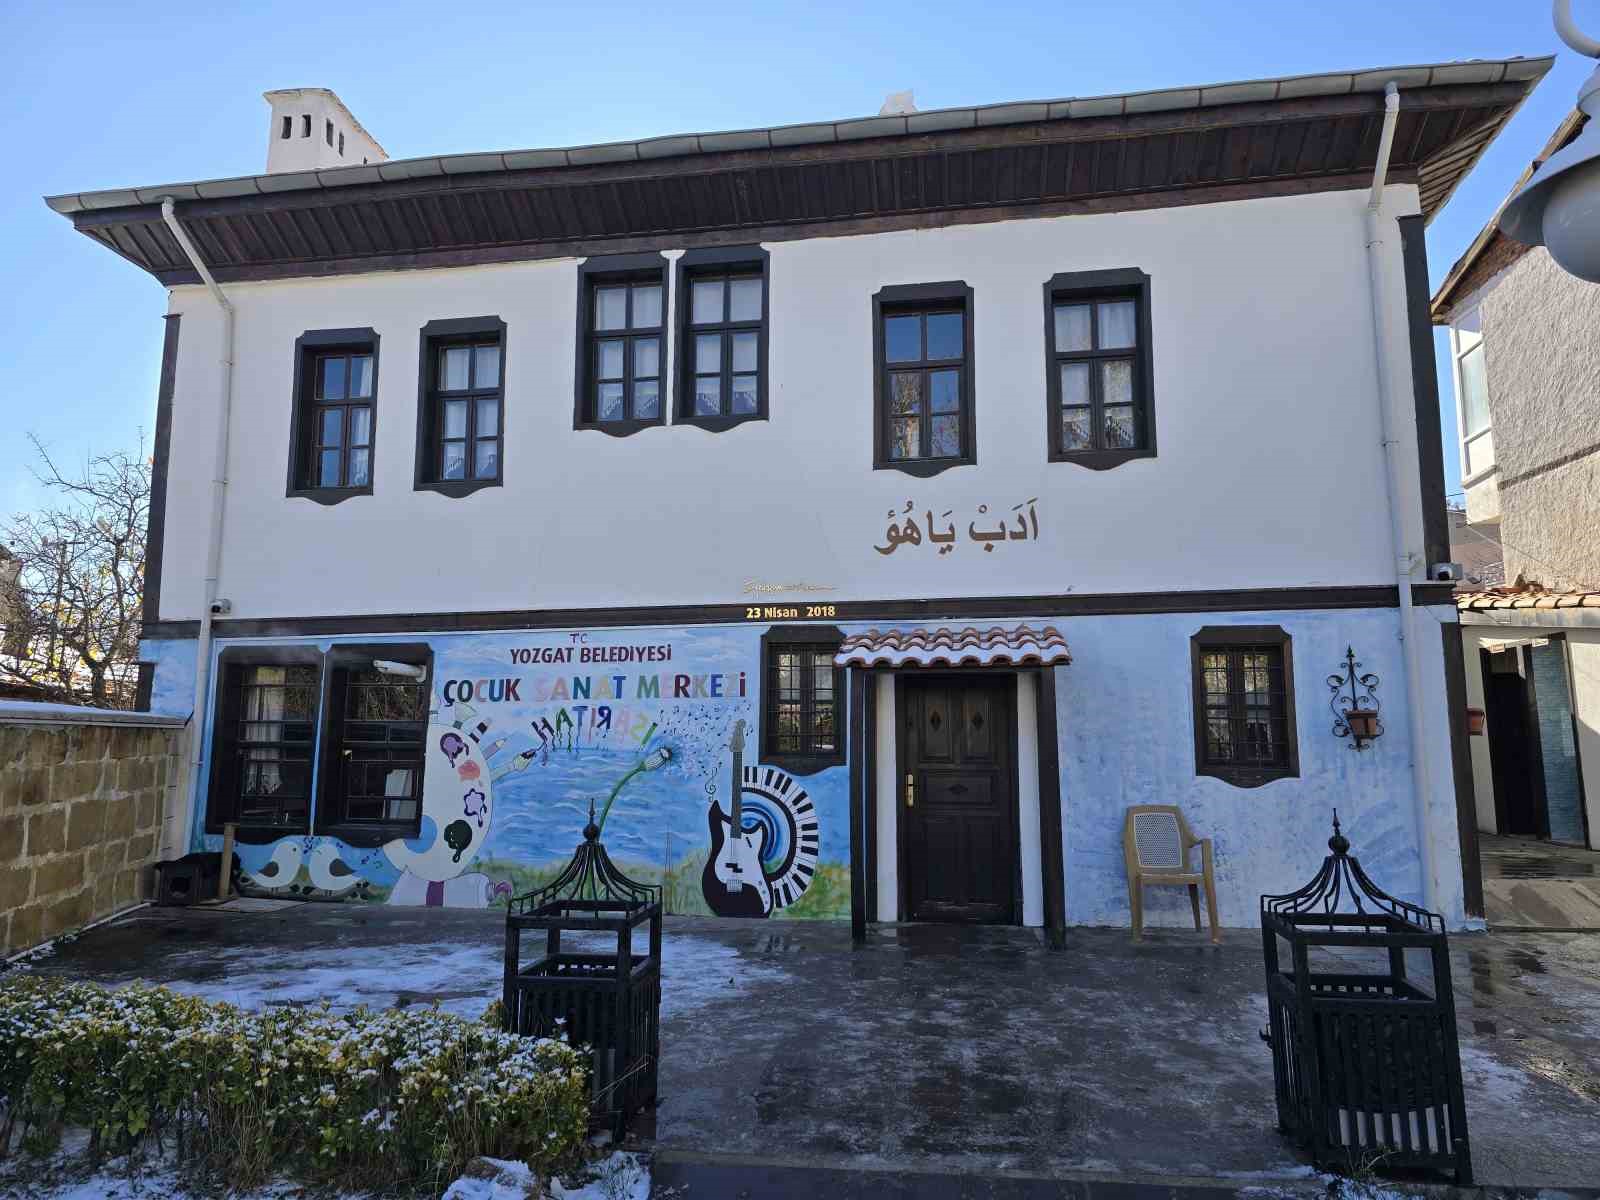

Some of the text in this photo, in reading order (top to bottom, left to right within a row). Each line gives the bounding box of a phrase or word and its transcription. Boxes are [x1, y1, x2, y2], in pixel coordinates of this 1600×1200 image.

[746, 605, 836, 619] 23 Nisan 2018
[510, 644, 672, 665] YOZGAT BELEDİYESİ
[443, 678, 521, 707] ÇOCUK
[534, 675, 626, 701] SANAT
